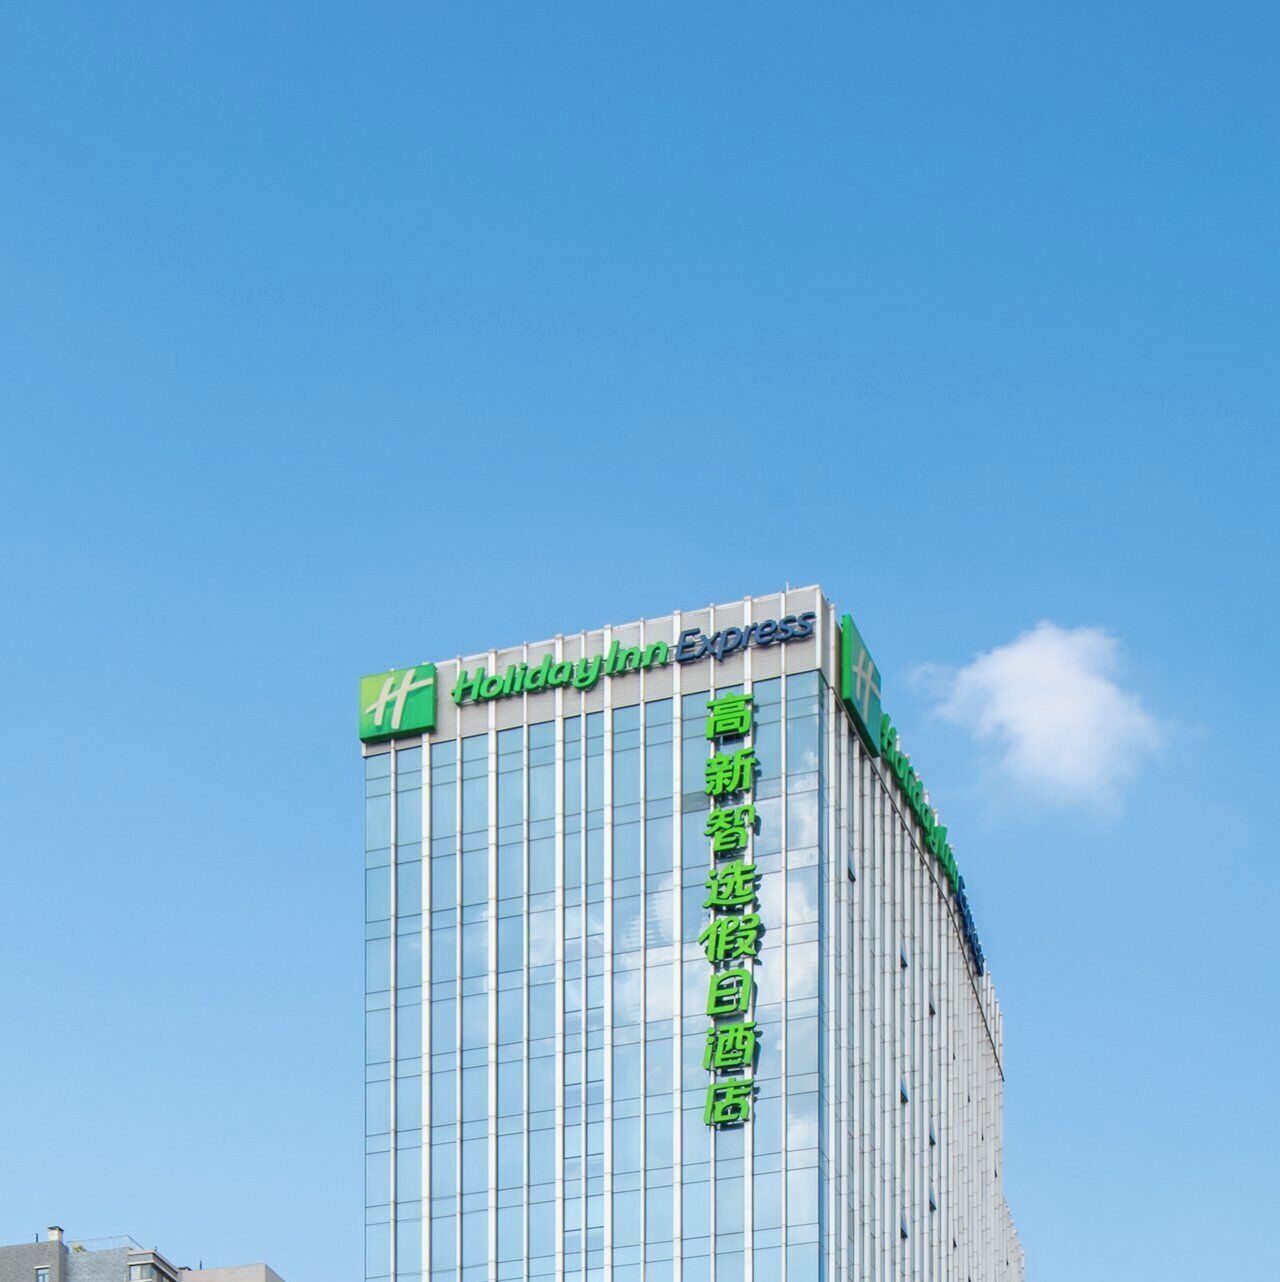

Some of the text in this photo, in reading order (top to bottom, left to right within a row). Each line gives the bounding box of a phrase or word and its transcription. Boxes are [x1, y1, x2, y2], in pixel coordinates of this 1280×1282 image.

[674, 611, 817, 663] Express
[698, 691, 761, 1126] 高新智选假日酒店
